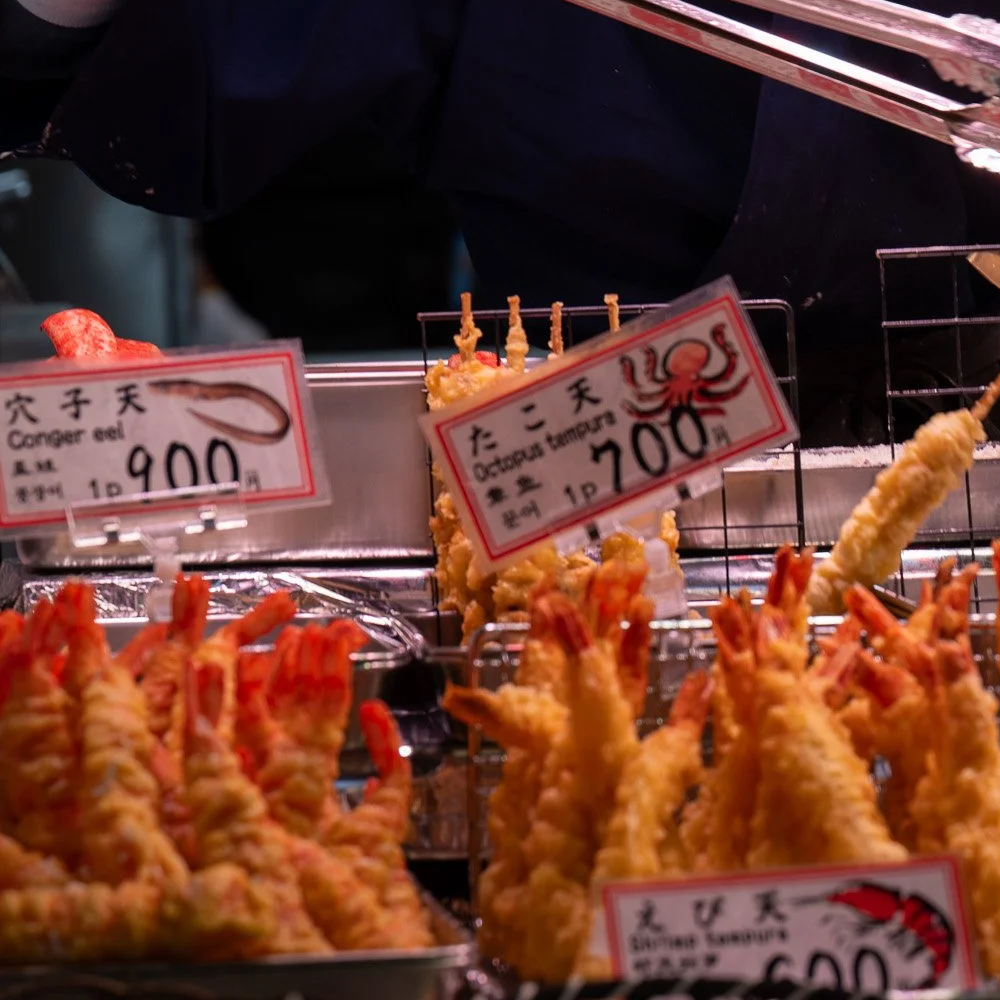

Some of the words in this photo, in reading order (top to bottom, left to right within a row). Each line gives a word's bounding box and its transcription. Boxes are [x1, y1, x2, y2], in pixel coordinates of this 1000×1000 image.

[5, 382, 147, 426] 穴子天
[469, 376, 601, 457] たこ天
[6, 427, 85, 452] Conger
[91, 421, 125, 444] eel
[473, 438, 546, 483] Octopus
[590, 404, 708, 493] 700
[128, 437, 241, 503] 900
